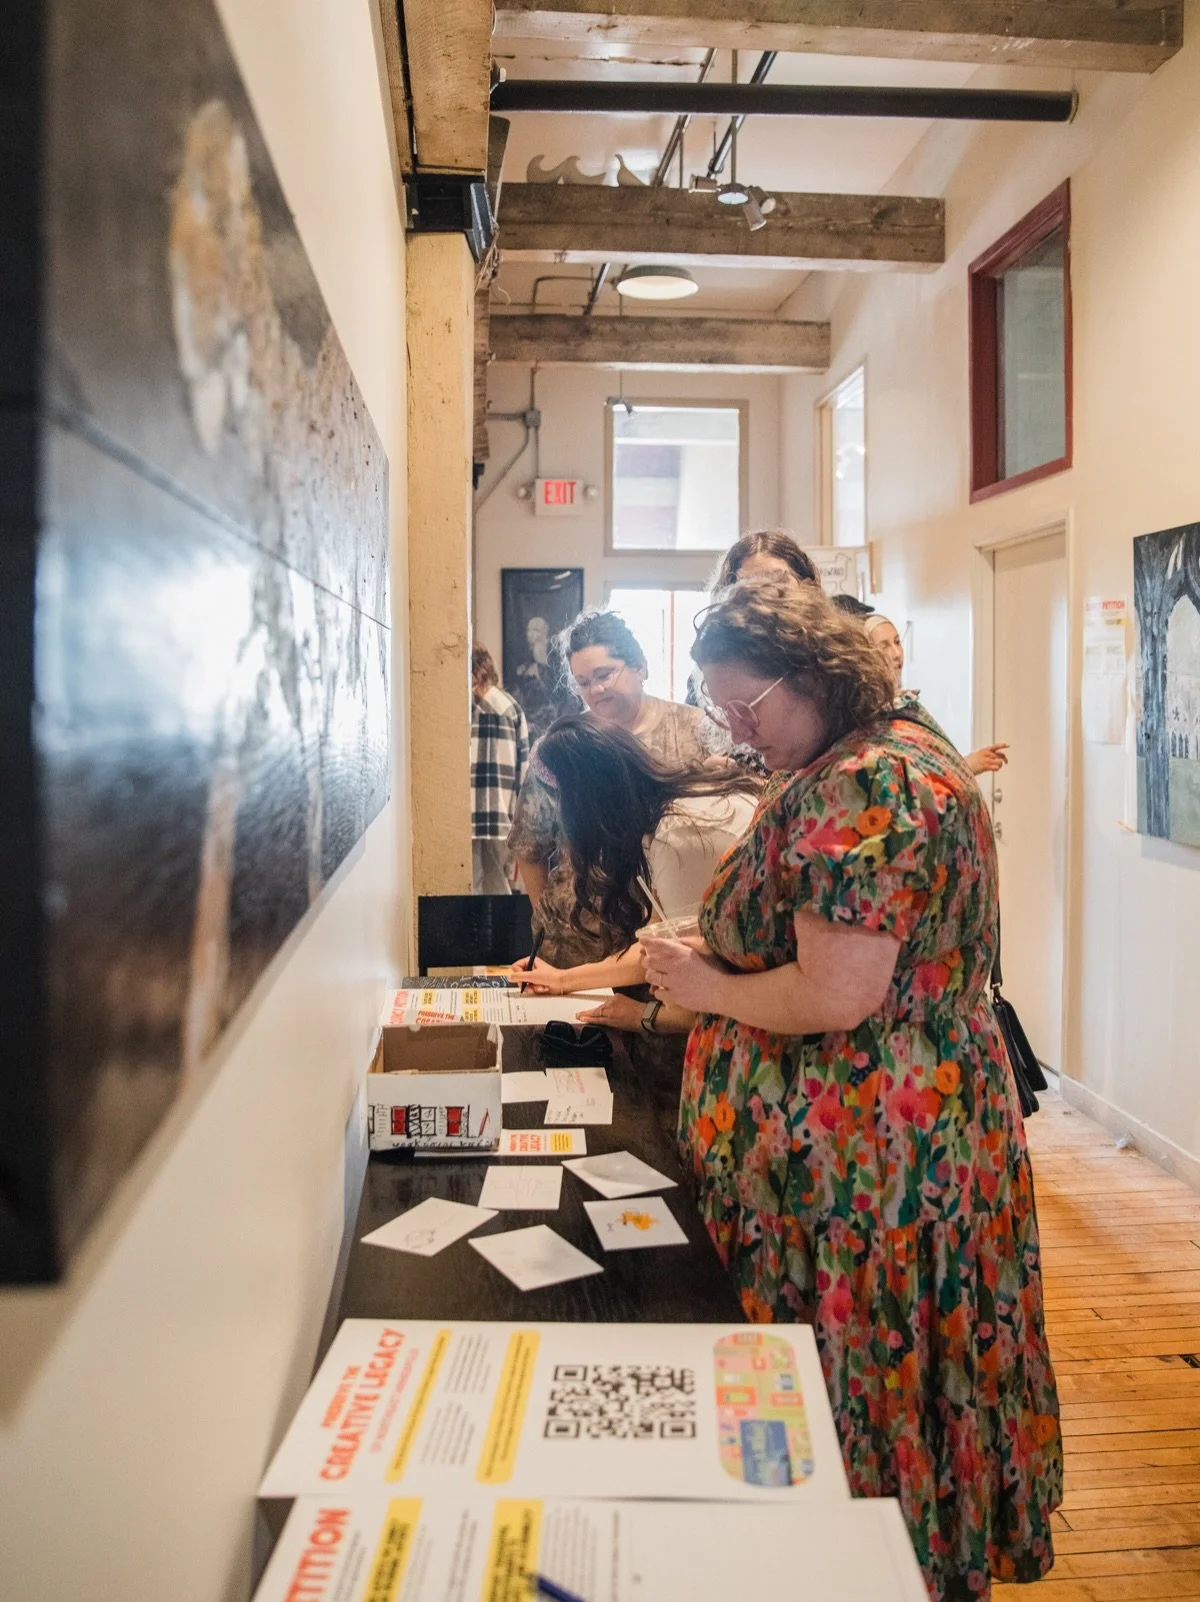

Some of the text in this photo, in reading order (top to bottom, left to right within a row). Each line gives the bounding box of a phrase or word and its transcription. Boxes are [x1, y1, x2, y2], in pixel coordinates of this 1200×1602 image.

[544, 481, 577, 505] EXIT
[320, 1393, 381, 1482] CREATIVE
[359, 1327, 405, 1389] LEGACY
[283, 1508, 352, 1602] TITION
